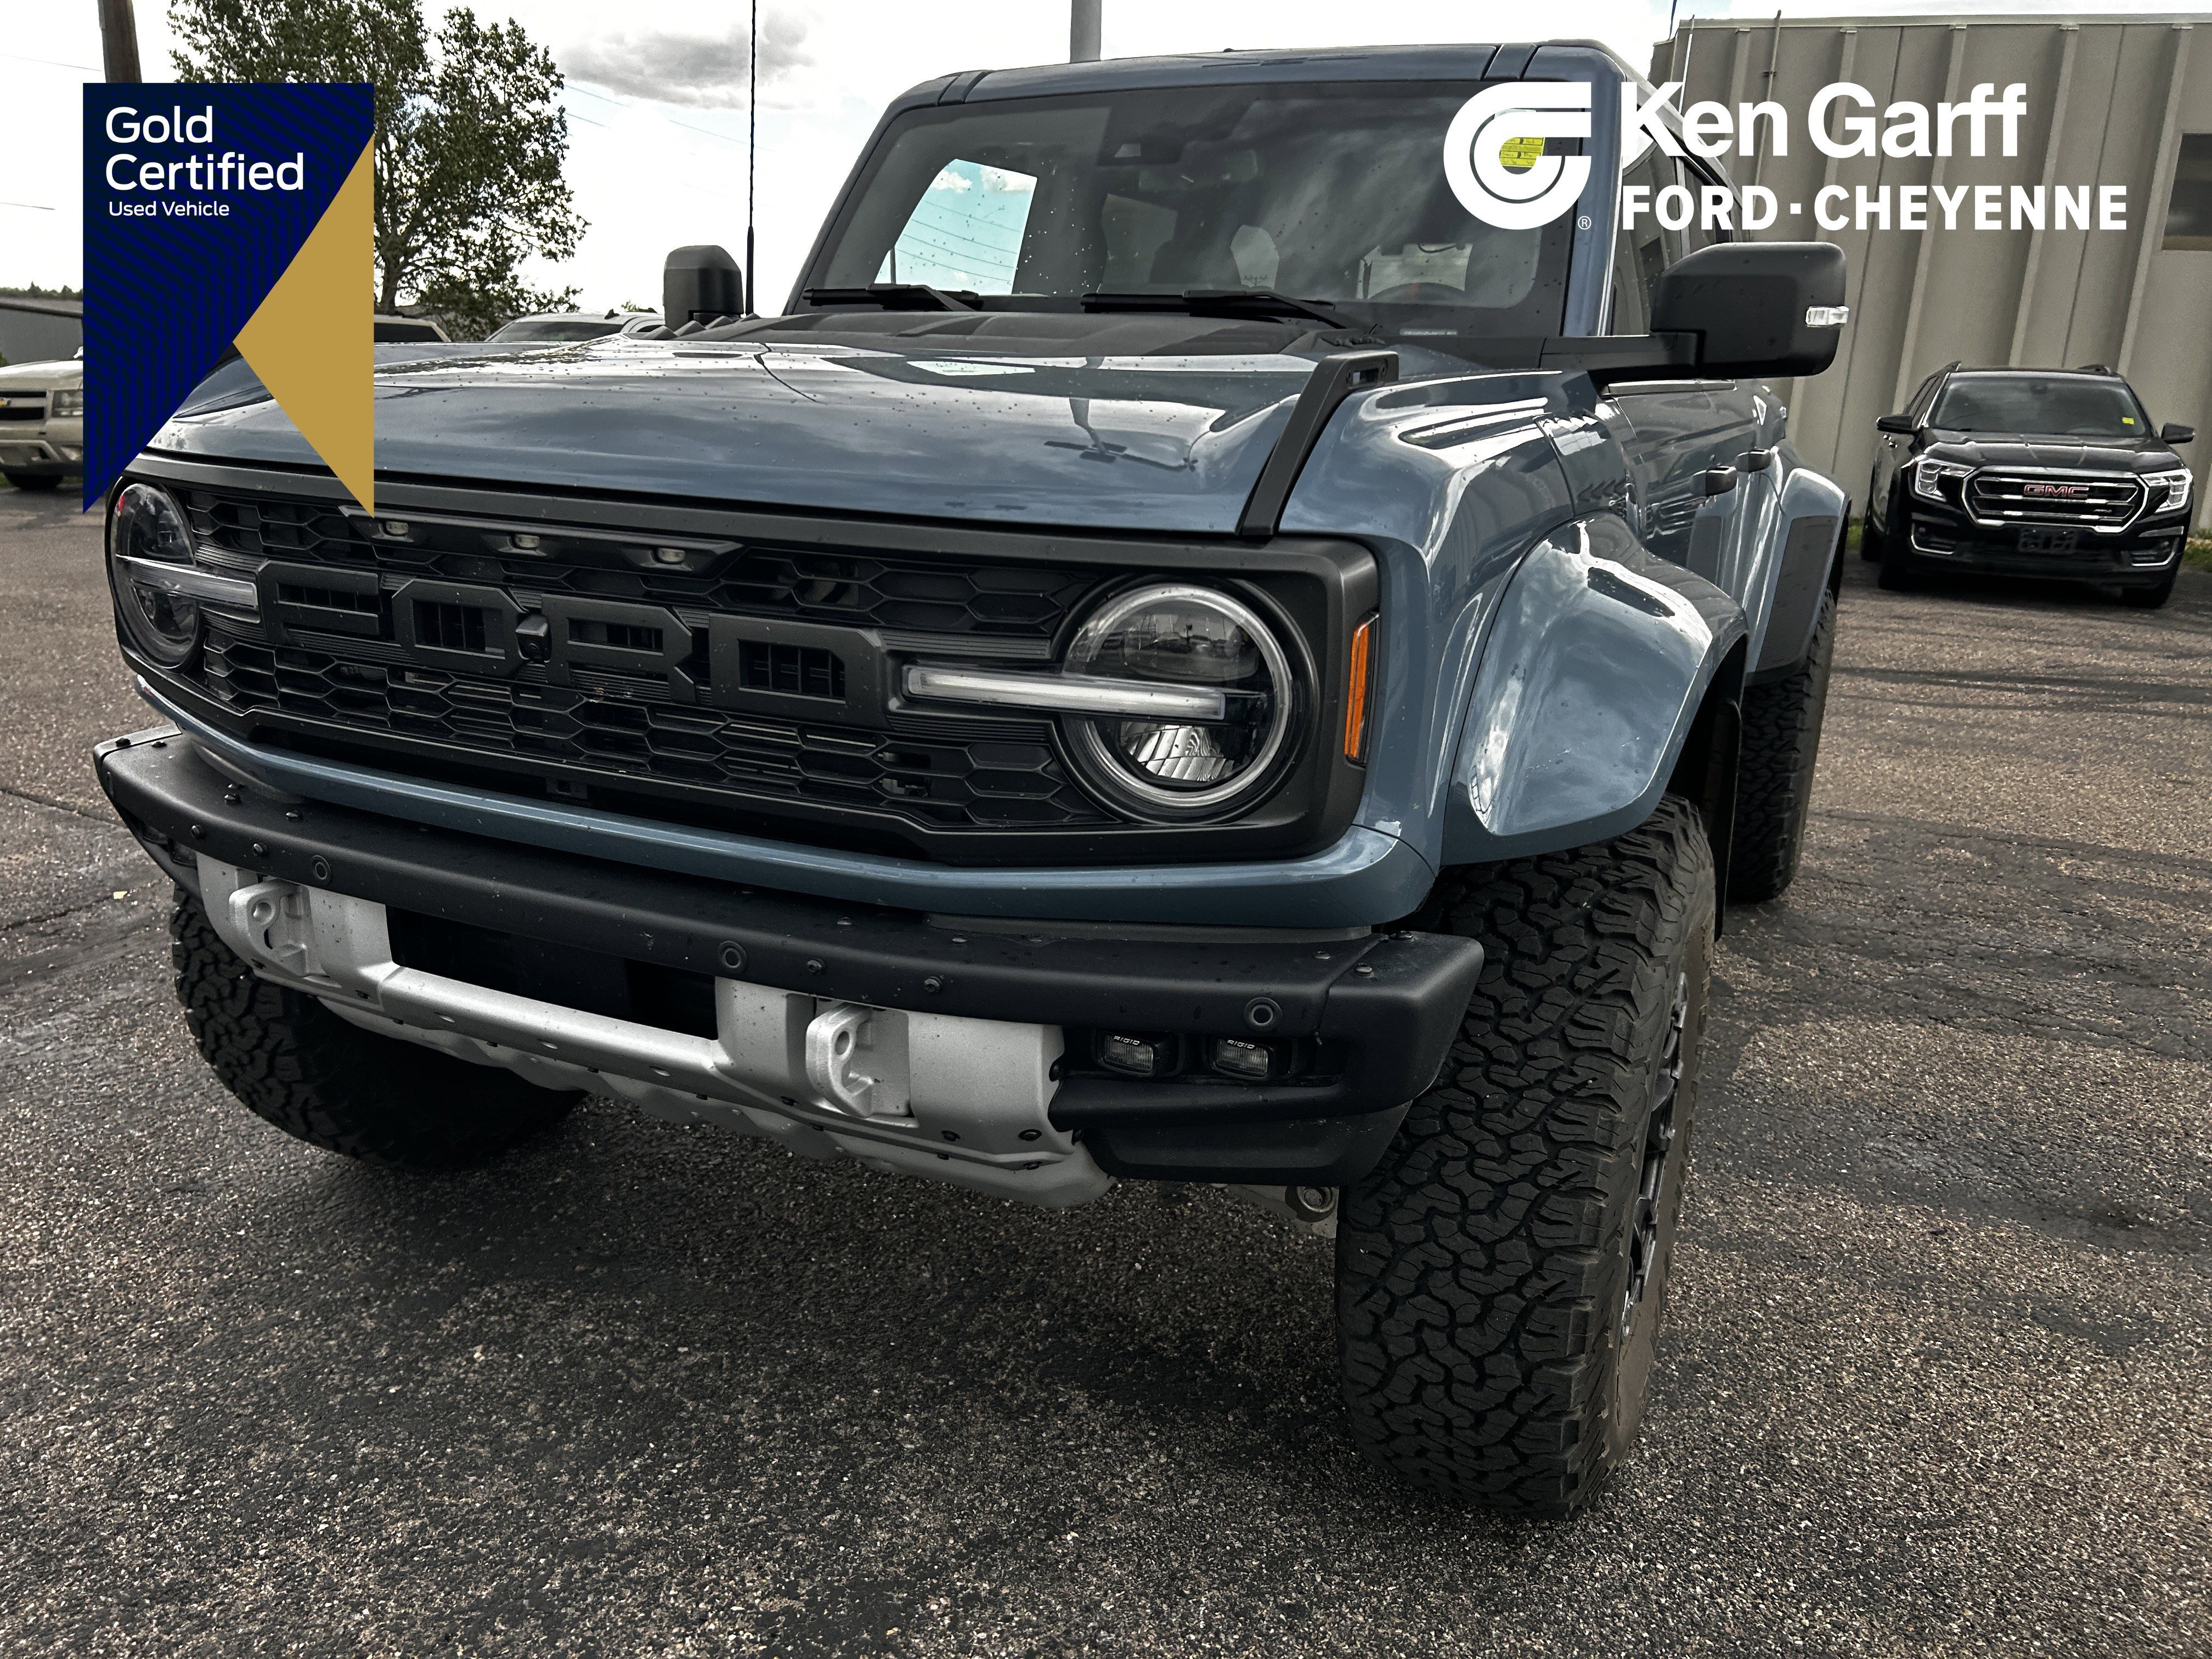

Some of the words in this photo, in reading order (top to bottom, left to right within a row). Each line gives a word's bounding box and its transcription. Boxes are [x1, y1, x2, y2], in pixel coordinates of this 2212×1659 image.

[2023, 483, 2090, 499] GMC
[257, 557, 889, 731] FORD
[1113, 1035, 1140, 1046] RIGID
[1227, 1039, 1255, 1049] RIGID
